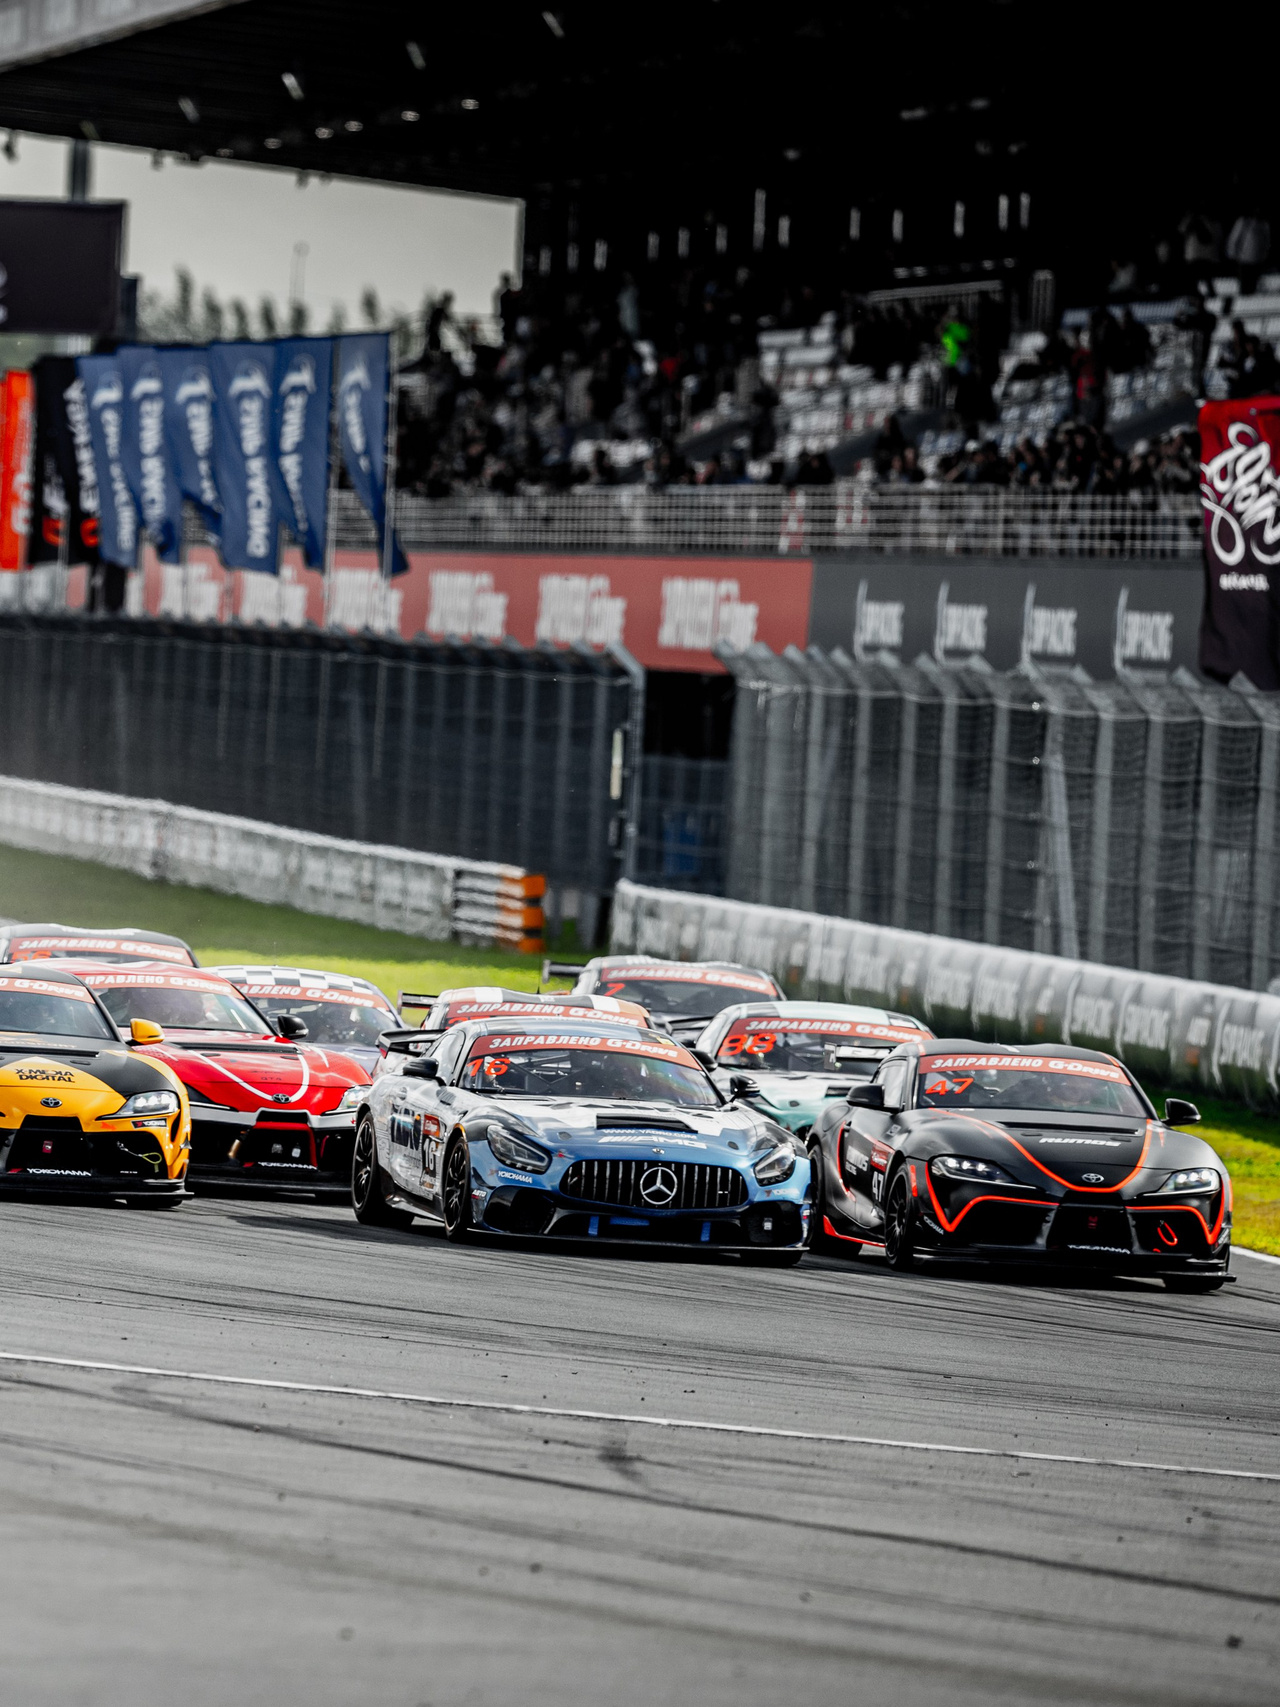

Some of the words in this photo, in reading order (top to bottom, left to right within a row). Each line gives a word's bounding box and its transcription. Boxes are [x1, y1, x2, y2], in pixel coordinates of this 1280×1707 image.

[85, 975, 165, 986] ПРАВЛЕНО
[239, 985, 302, 996] АВЛЕНО
[456, 1002, 565, 1014] ЗАПРАВЛЕНО
[745, 1021, 851, 1032] ЗАПРАВЛЕНО
[489, 1036, 601, 1049] ЗАПРАВЛЕНО
[718, 1033, 778, 1056] 88
[466, 1058, 511, 1077] 16
[931, 1057, 1044, 1069] ЗАПРАВЛЕНО
[19, 1074, 76, 1083] DIGITAL
[925, 1078, 974, 1095] 47
[423, 1138, 436, 1171] 16
[26, 1168, 92, 1177] YOKOHAMA
[498, 1170, 533, 1184] YOKOHAMA
[872, 1171, 884, 1202] 47
